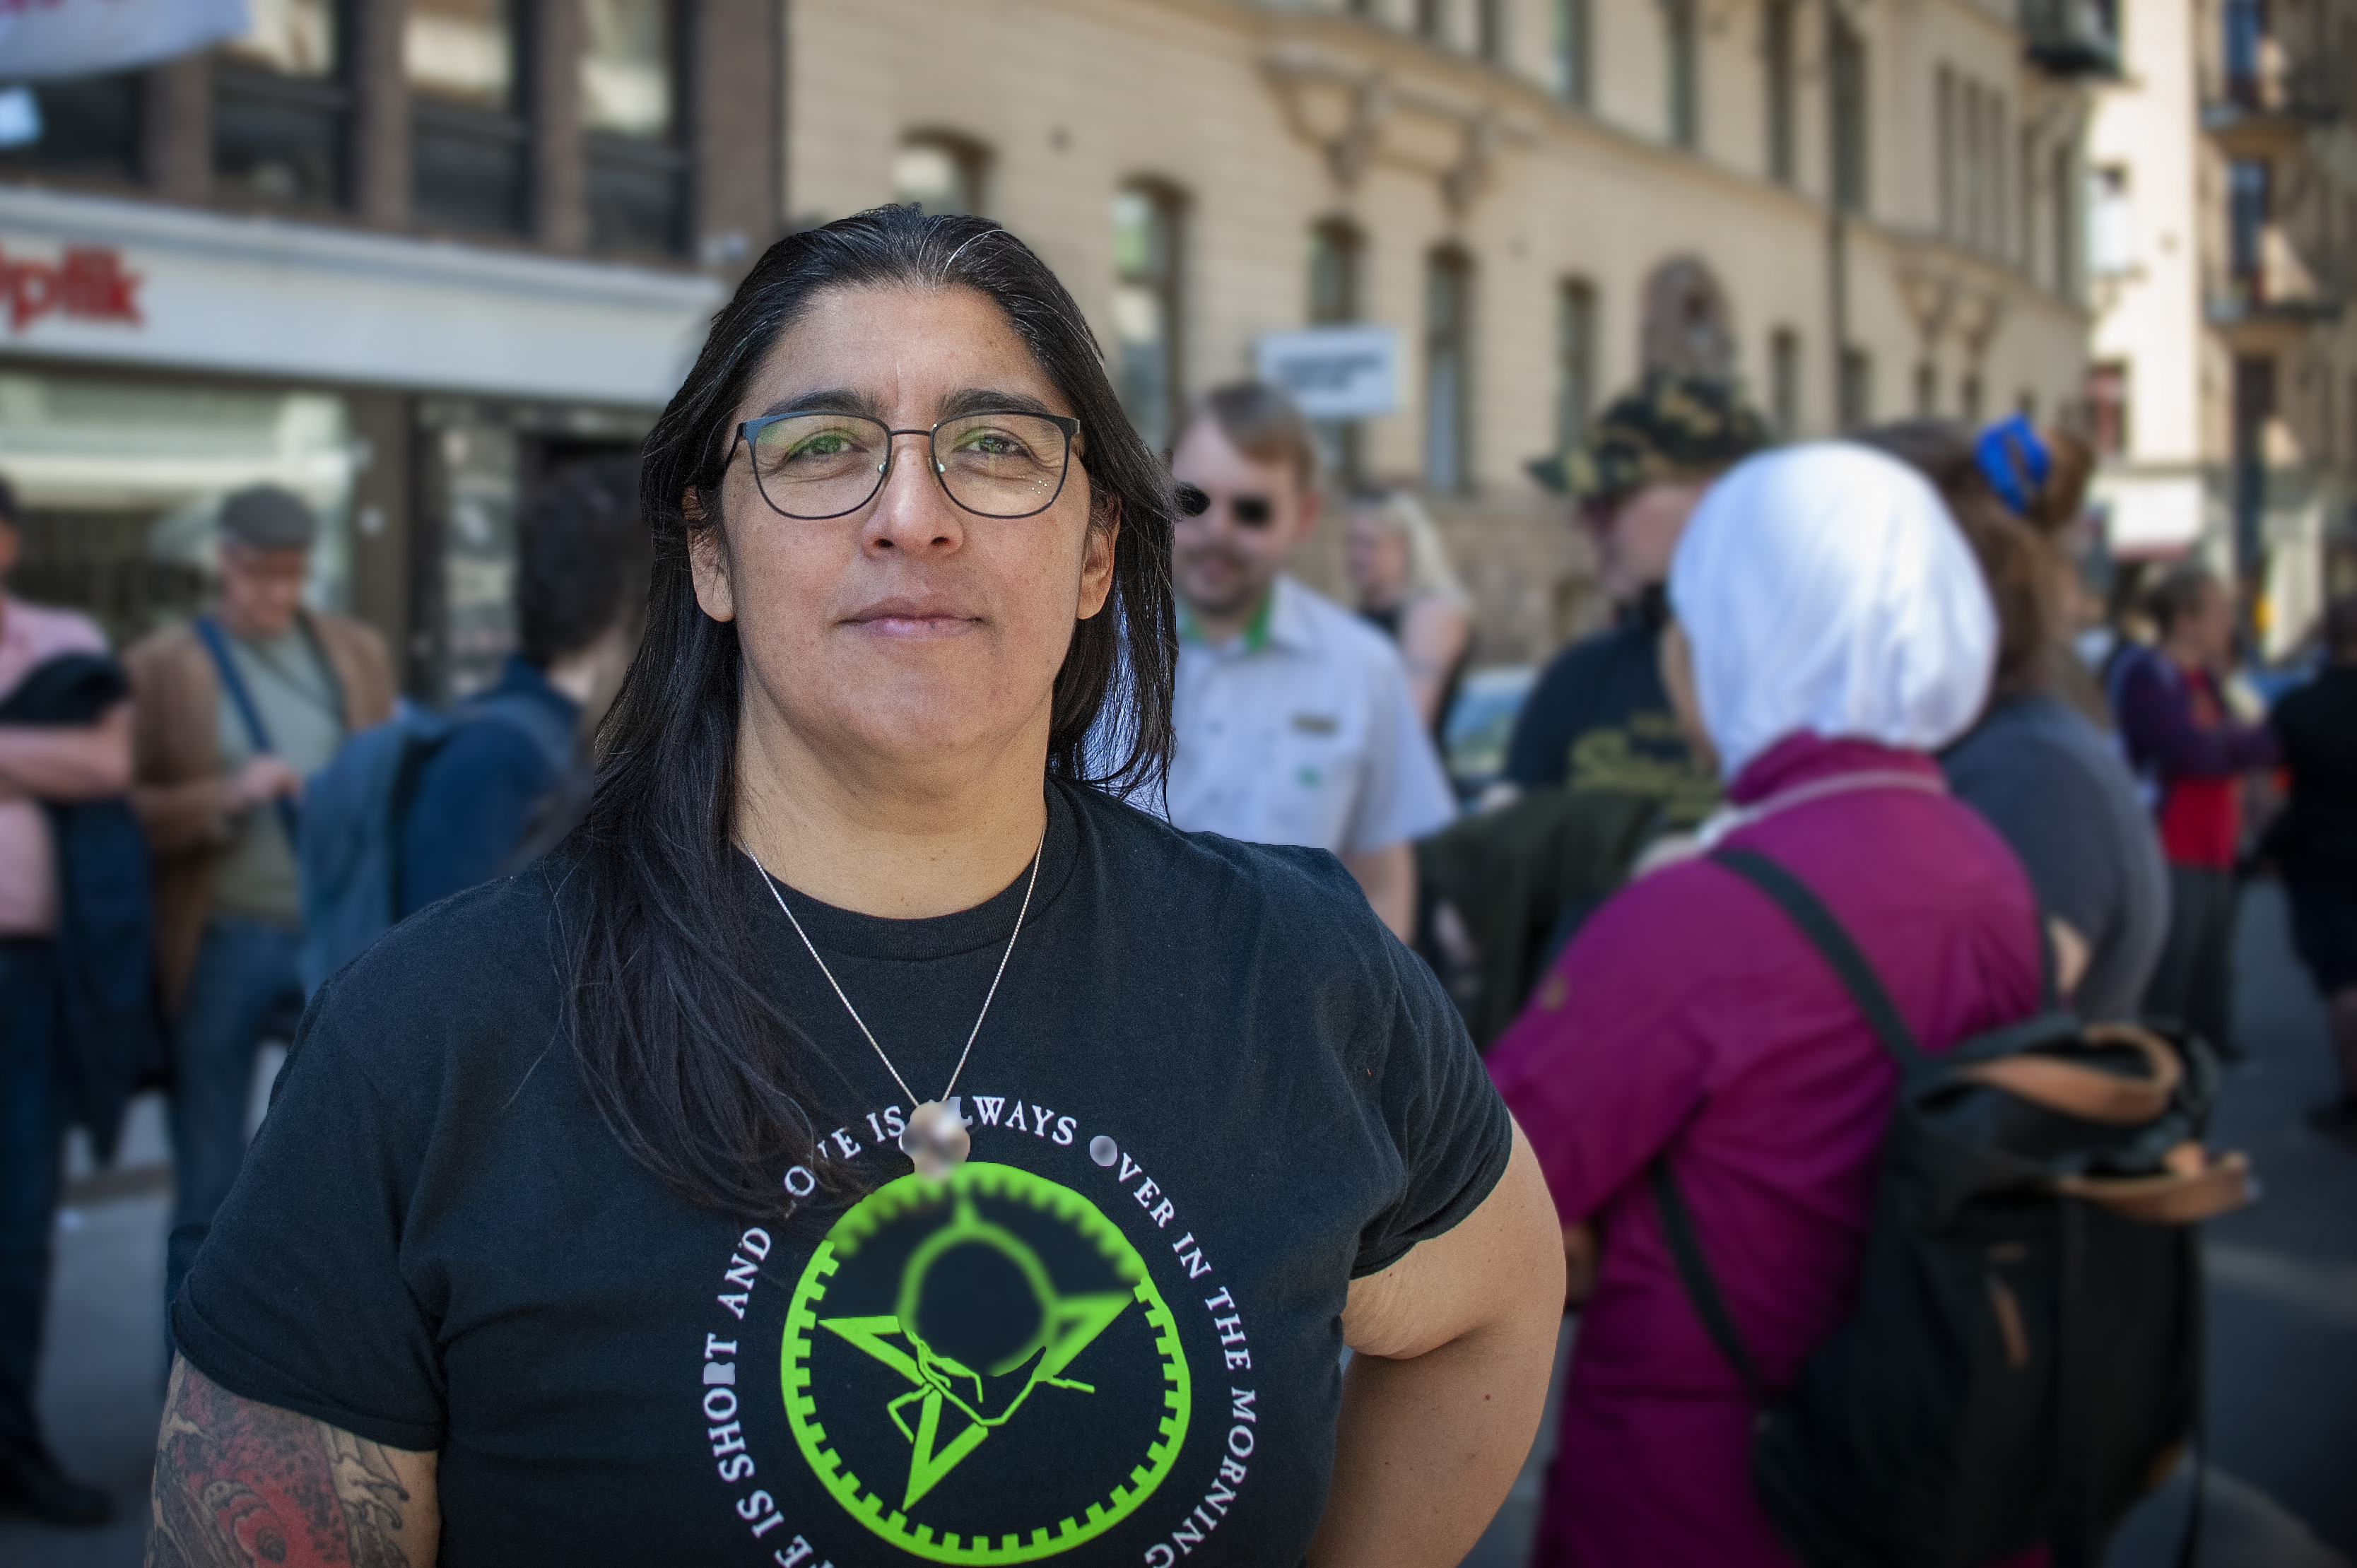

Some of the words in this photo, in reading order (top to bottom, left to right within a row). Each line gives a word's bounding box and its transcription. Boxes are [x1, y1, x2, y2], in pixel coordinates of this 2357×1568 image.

[866, 1106, 905, 1143] IS
[783, 1128, 861, 1217] OE
[717, 1227, 771, 1319] AND
[1172, 1232, 1211, 1279] IN
[1205, 1286, 1251, 1370] THE
[736, 1490, 784, 1538] IS
[1144, 1386, 1257, 1568] MORNING
